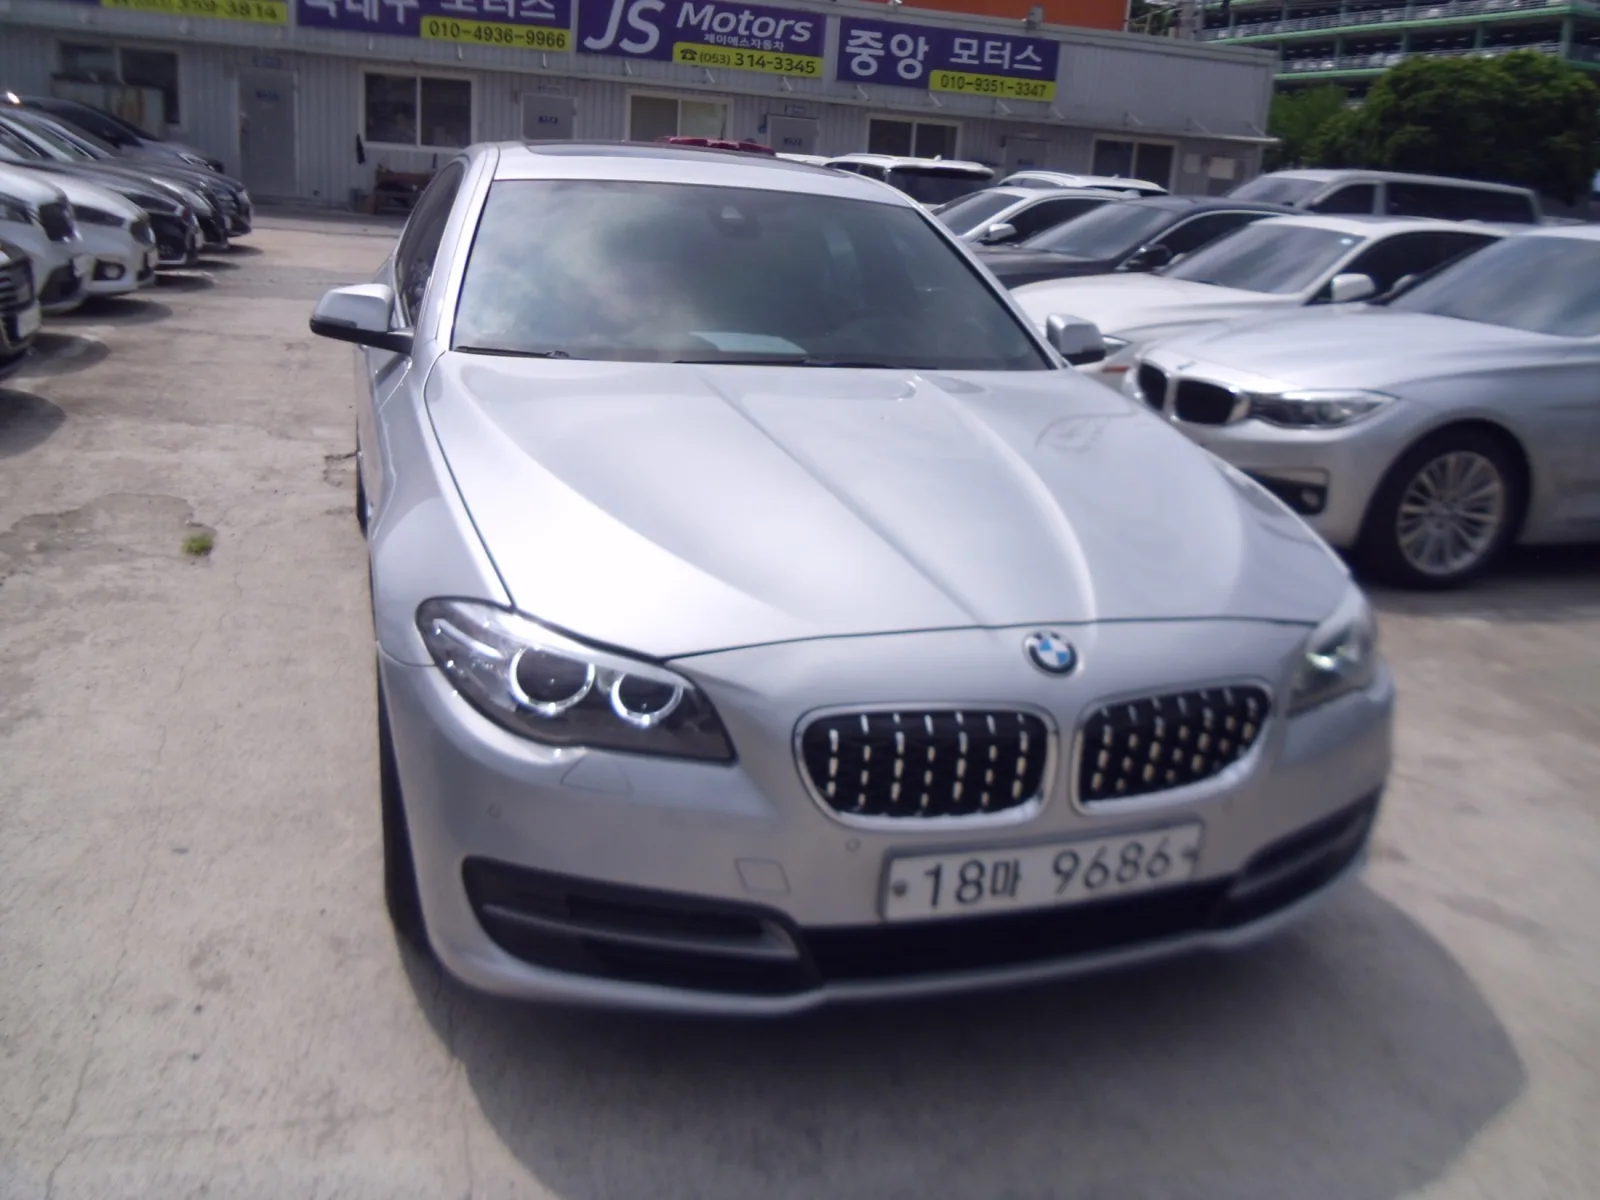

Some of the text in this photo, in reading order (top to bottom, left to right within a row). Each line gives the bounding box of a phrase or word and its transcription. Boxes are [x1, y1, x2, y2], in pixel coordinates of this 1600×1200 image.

[428, 19, 566, 49] 010-4936-9966
[583, 0, 814, 54] JS Motors
[699, 51, 816, 75] (053) 314-3345
[845, 29, 1043, 80] 중앙 모터스
[940, 73, 1047, 98] 010-9351-3347
[924, 836, 1172, 908] 18마 9686
